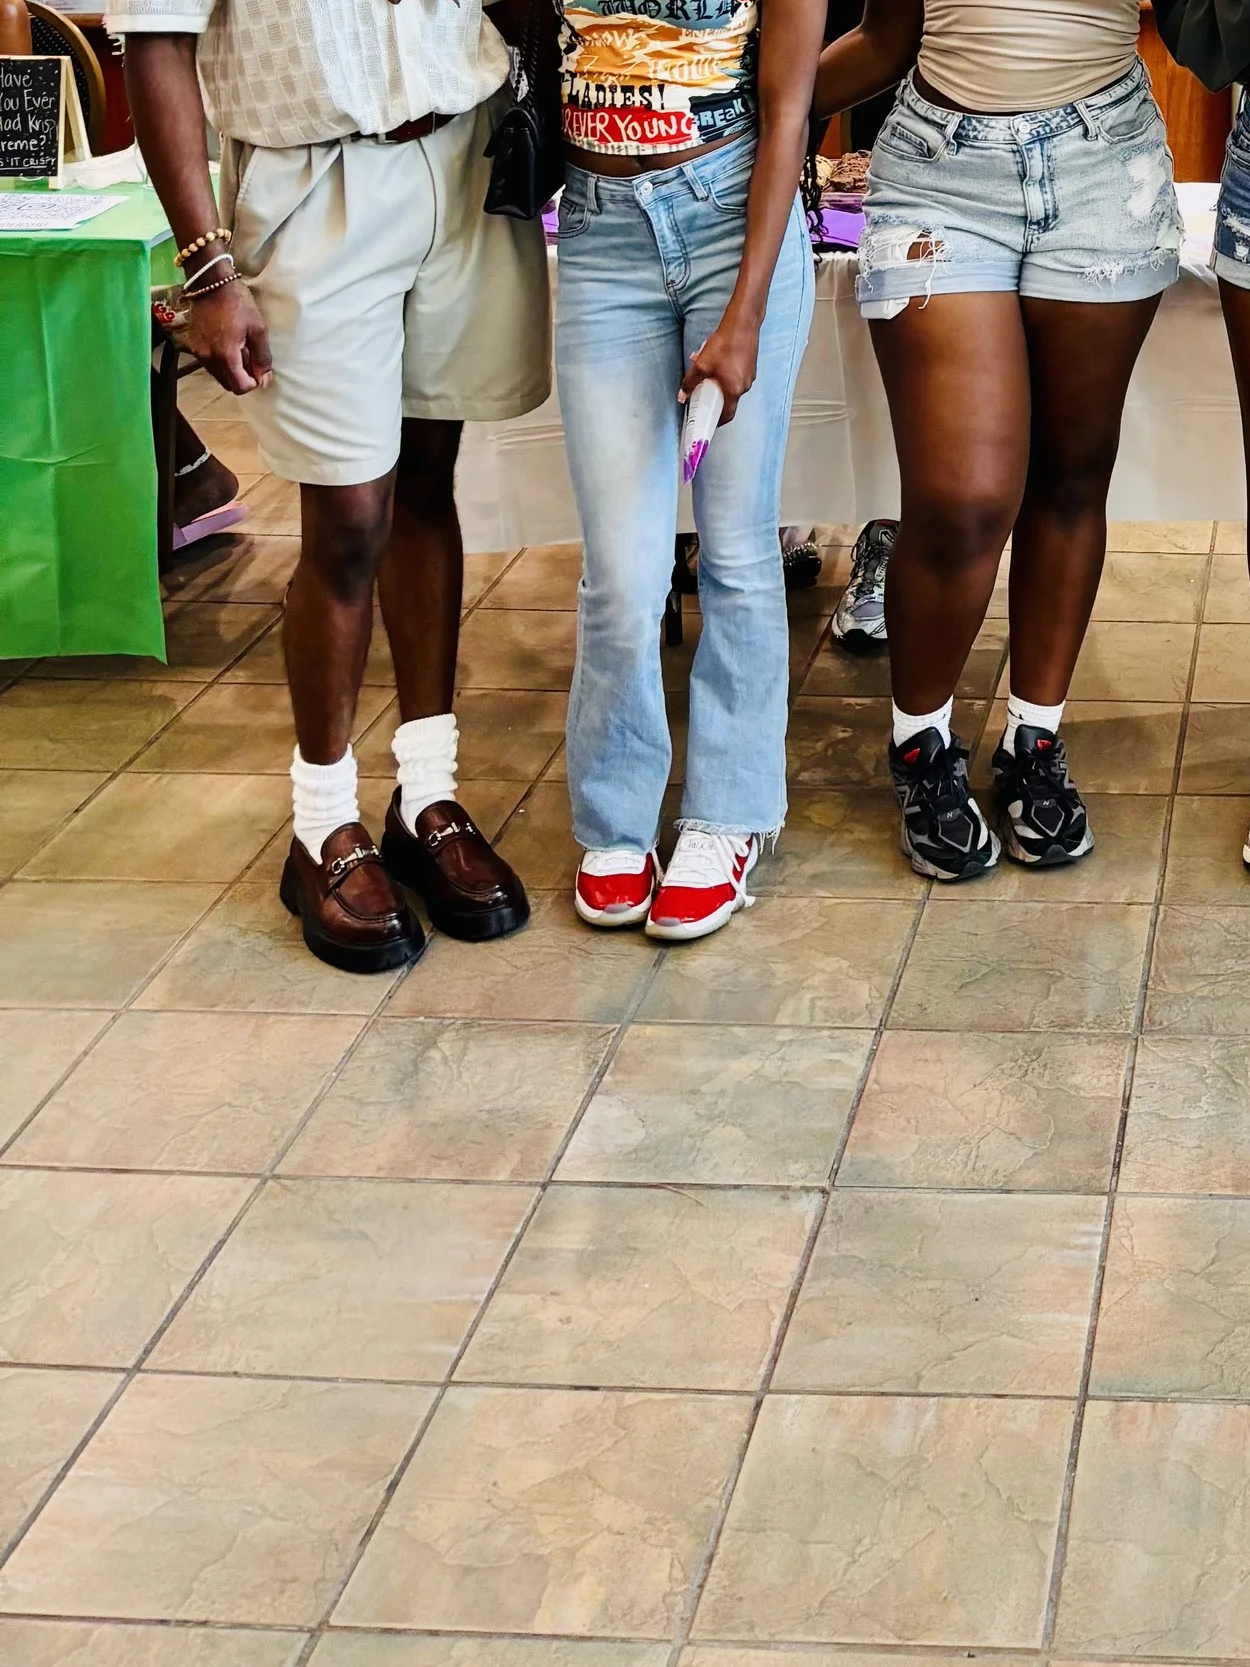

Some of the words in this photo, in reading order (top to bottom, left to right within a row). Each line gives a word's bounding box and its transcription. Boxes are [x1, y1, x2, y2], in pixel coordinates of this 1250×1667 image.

[23, 88, 56, 112] Ever
[561, 108, 615, 143] REVER
[612, 112, 691, 144] YOUNG
[0, 134, 46, 152] reme?
[22, 155, 56, 167] CRISPY
